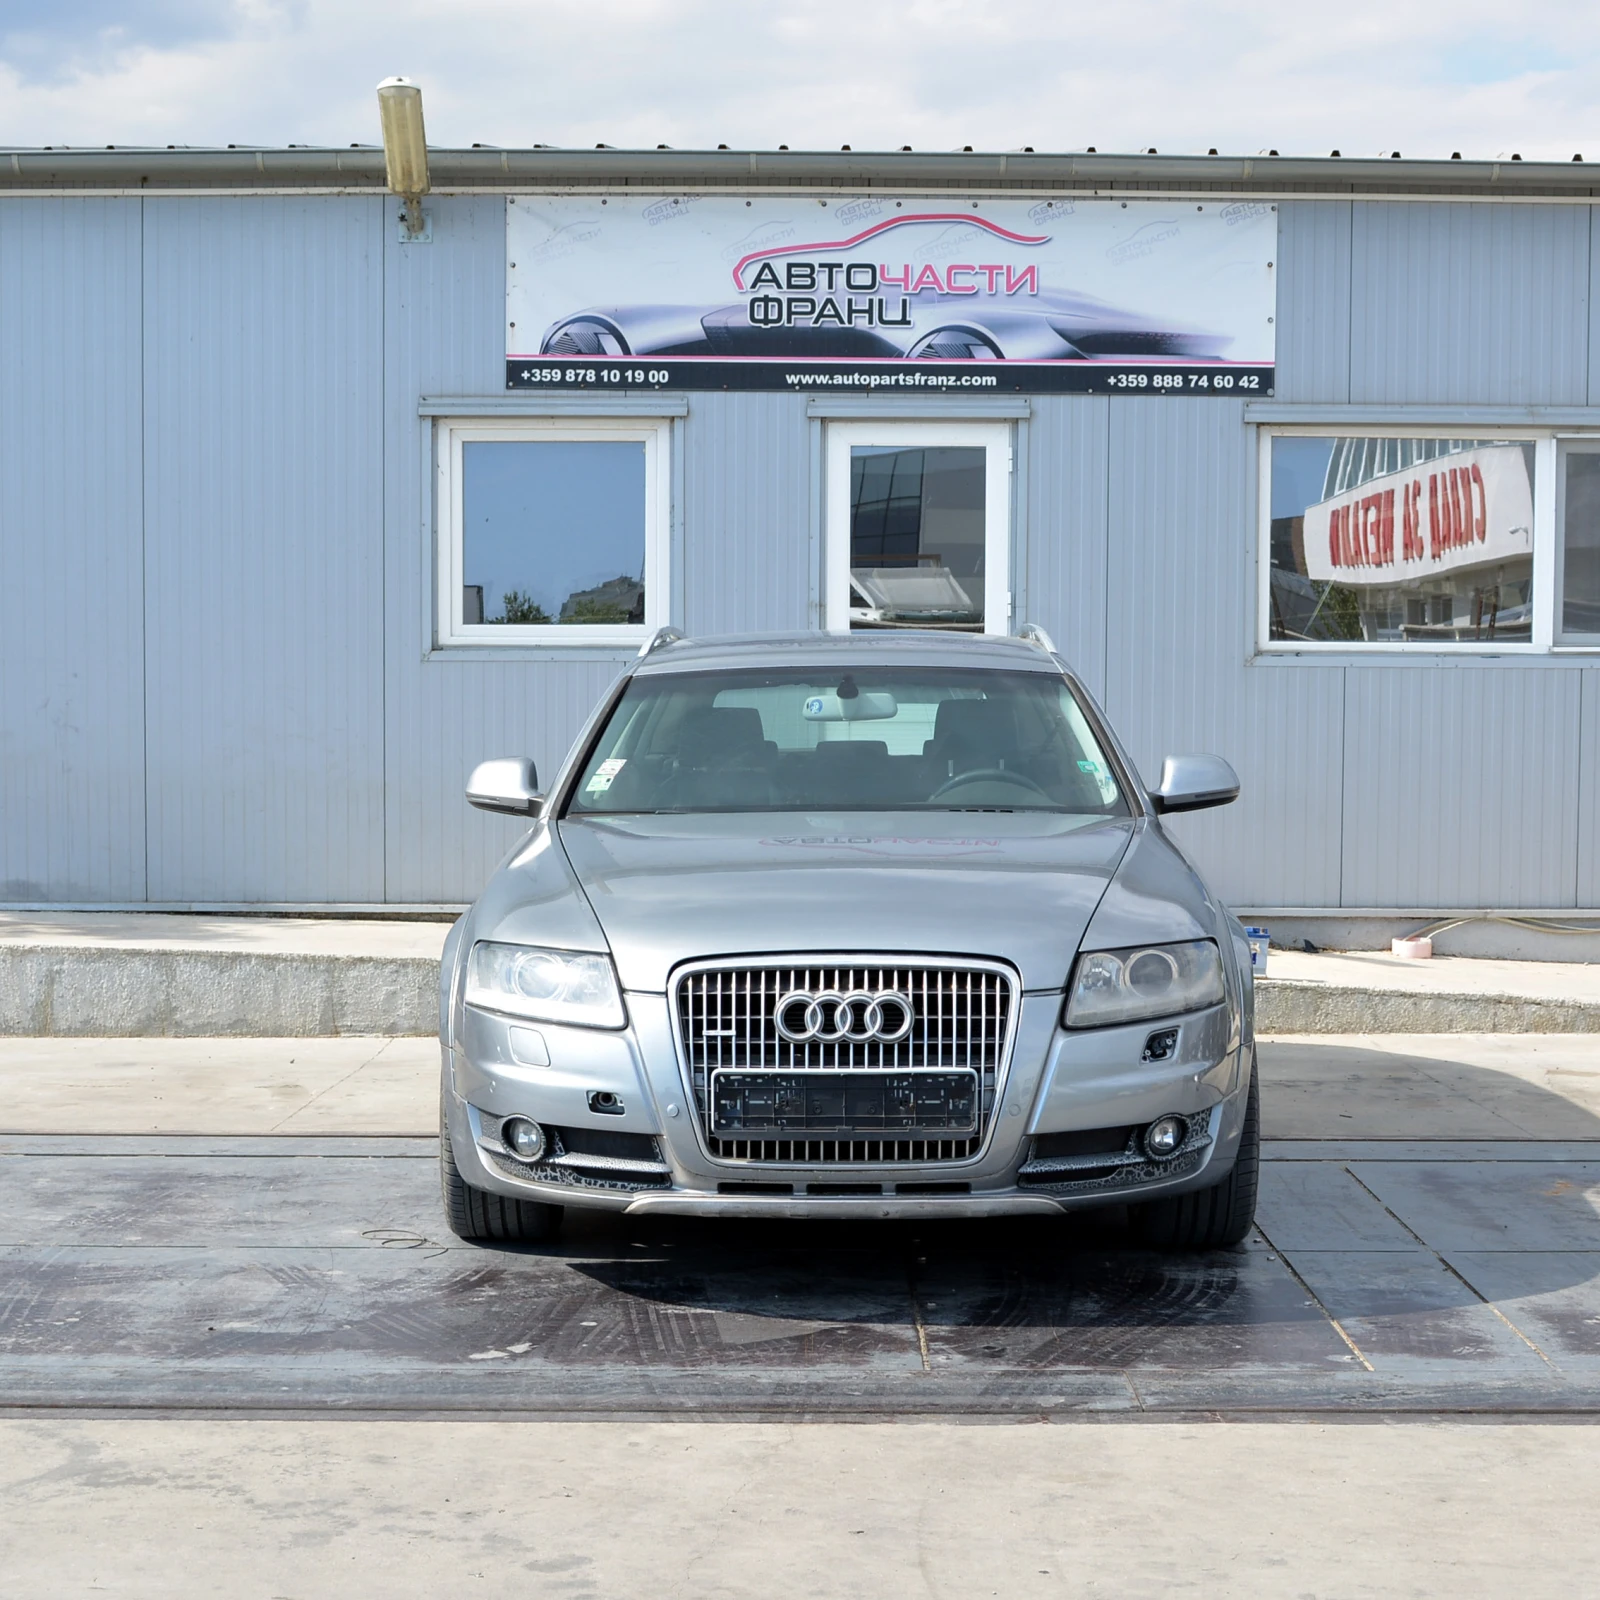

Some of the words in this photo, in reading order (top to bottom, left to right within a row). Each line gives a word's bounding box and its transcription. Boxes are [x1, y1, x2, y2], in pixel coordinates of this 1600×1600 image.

[749, 261, 1037, 293] АВТОЧАСТИ
[749, 294, 912, 327] ФРАНЦ
[521, 369, 562, 382] +359
[565, 369, 596, 383] 878
[600, 369, 620, 383] 10
[624, 370, 645, 383] 19
[648, 370, 669, 383] 00
[785, 372, 997, 388] www.autopartsfranz.com
[1107, 374, 1148, 388] +359
[1152, 374, 1184, 388] 888
[1188, 375, 1209, 388] 74
[1213, 375, 1234, 389] 60
[1238, 375, 1260, 389] 42
